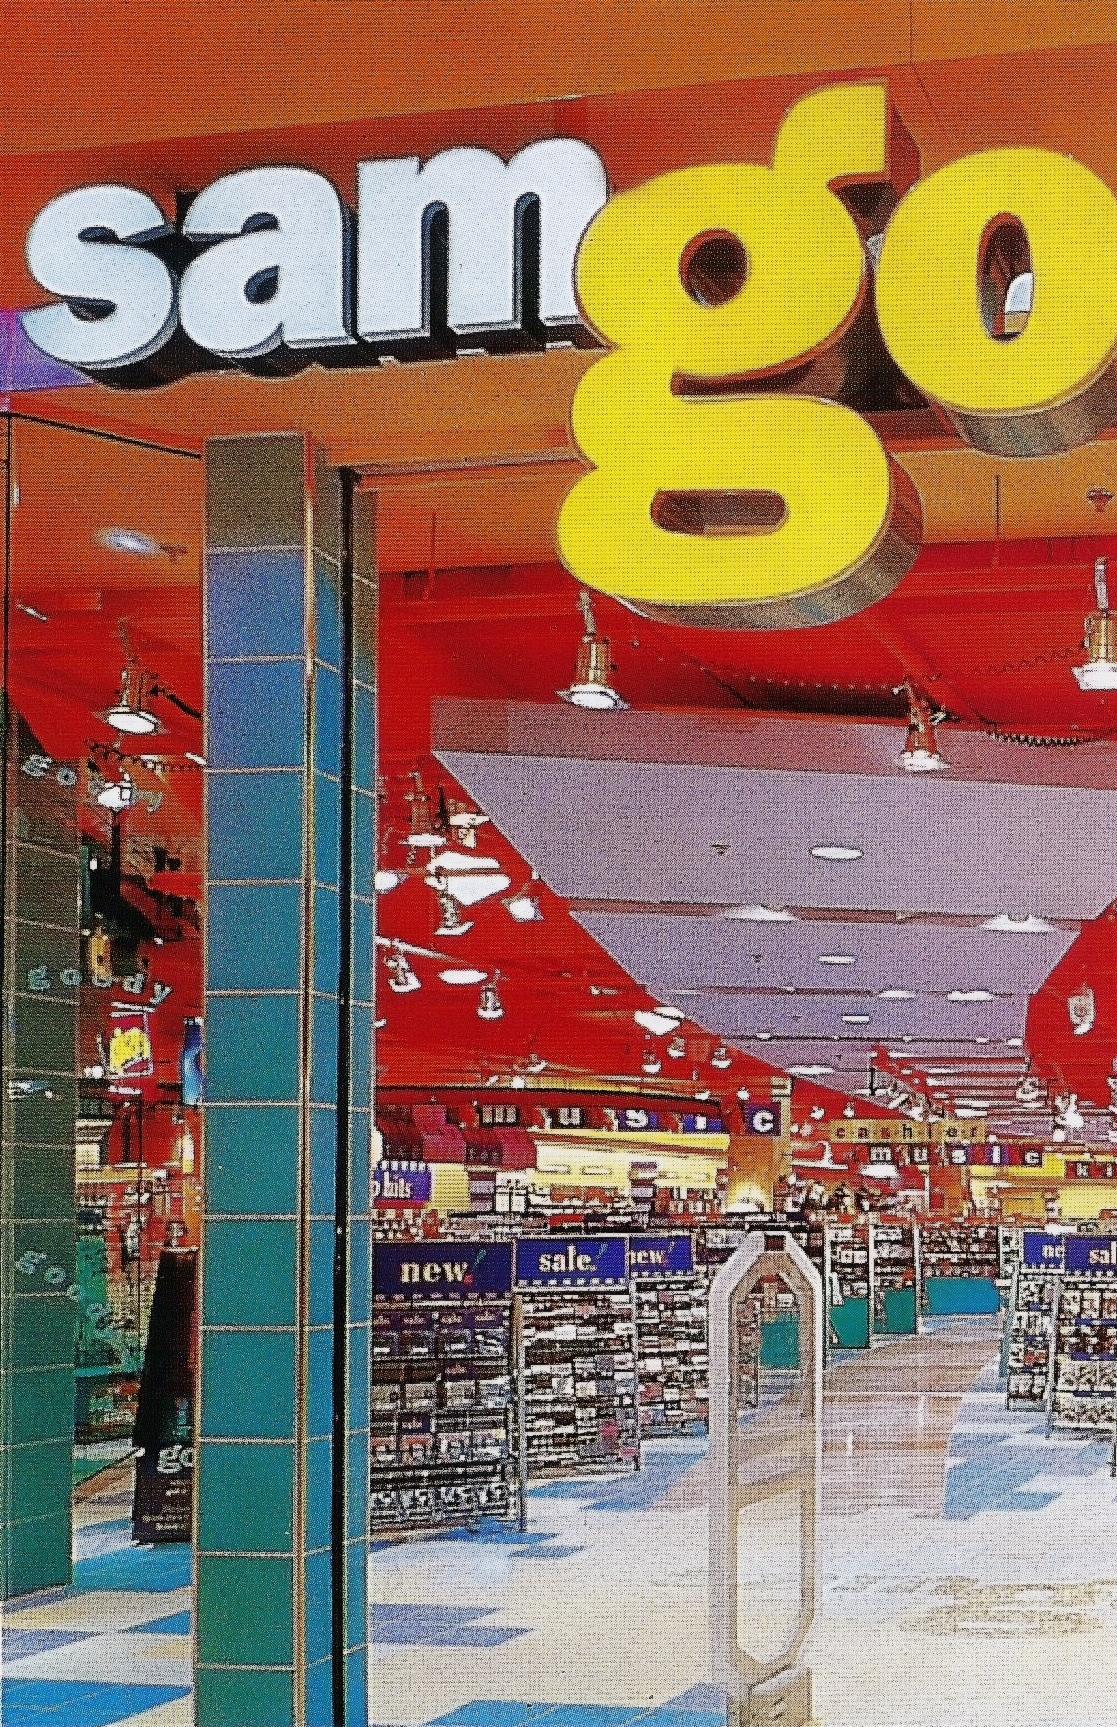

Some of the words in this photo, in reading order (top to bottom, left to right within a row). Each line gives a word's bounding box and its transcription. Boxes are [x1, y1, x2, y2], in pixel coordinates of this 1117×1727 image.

[22, 137, 607, 368] sam
[484, 1105, 775, 1134] music
[836, 1123, 979, 1140] cashier
[870, 1145, 1041, 1164] music
[156, 1444, 194, 1475] go
